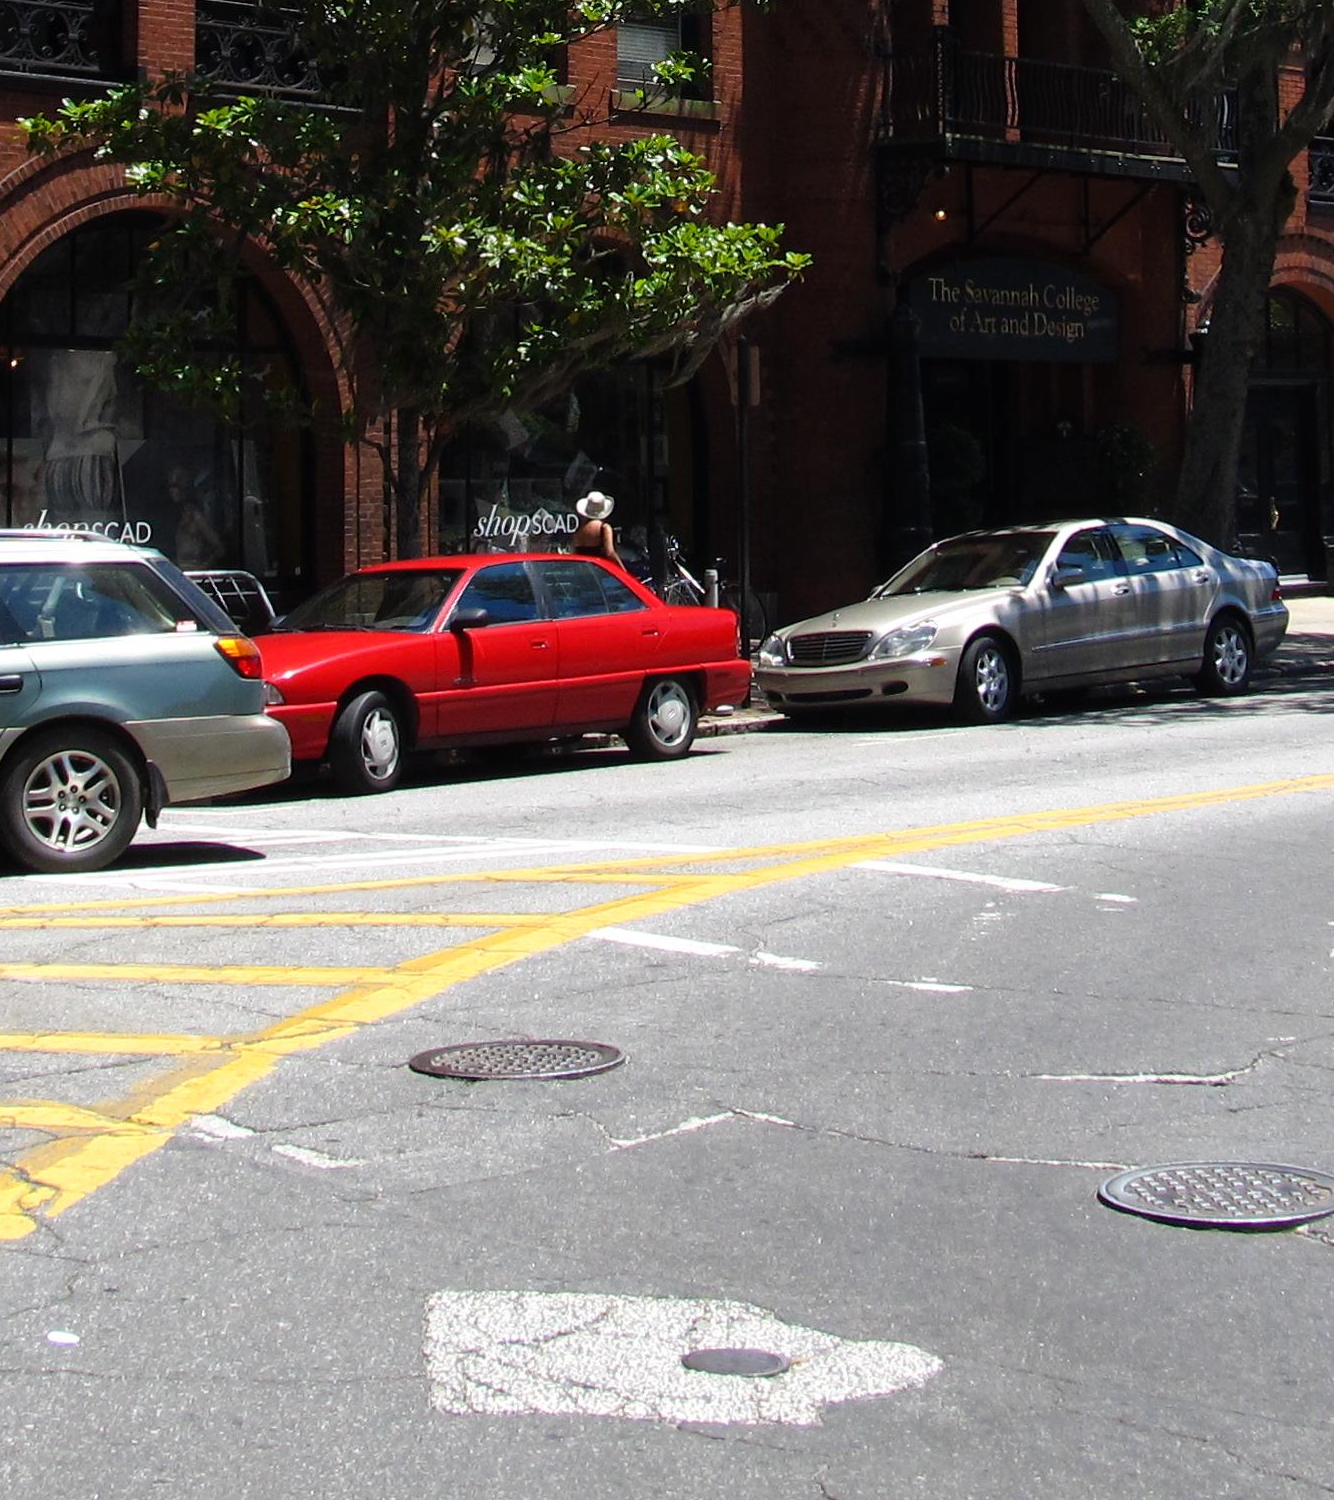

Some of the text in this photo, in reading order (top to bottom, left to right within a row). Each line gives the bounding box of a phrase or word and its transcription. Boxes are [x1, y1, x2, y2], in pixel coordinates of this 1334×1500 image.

[929, 277, 1099, 316] The Savannah College
[949, 307, 1084, 343] of Art and Design
[473, 504, 579, 547] shopSCAD
